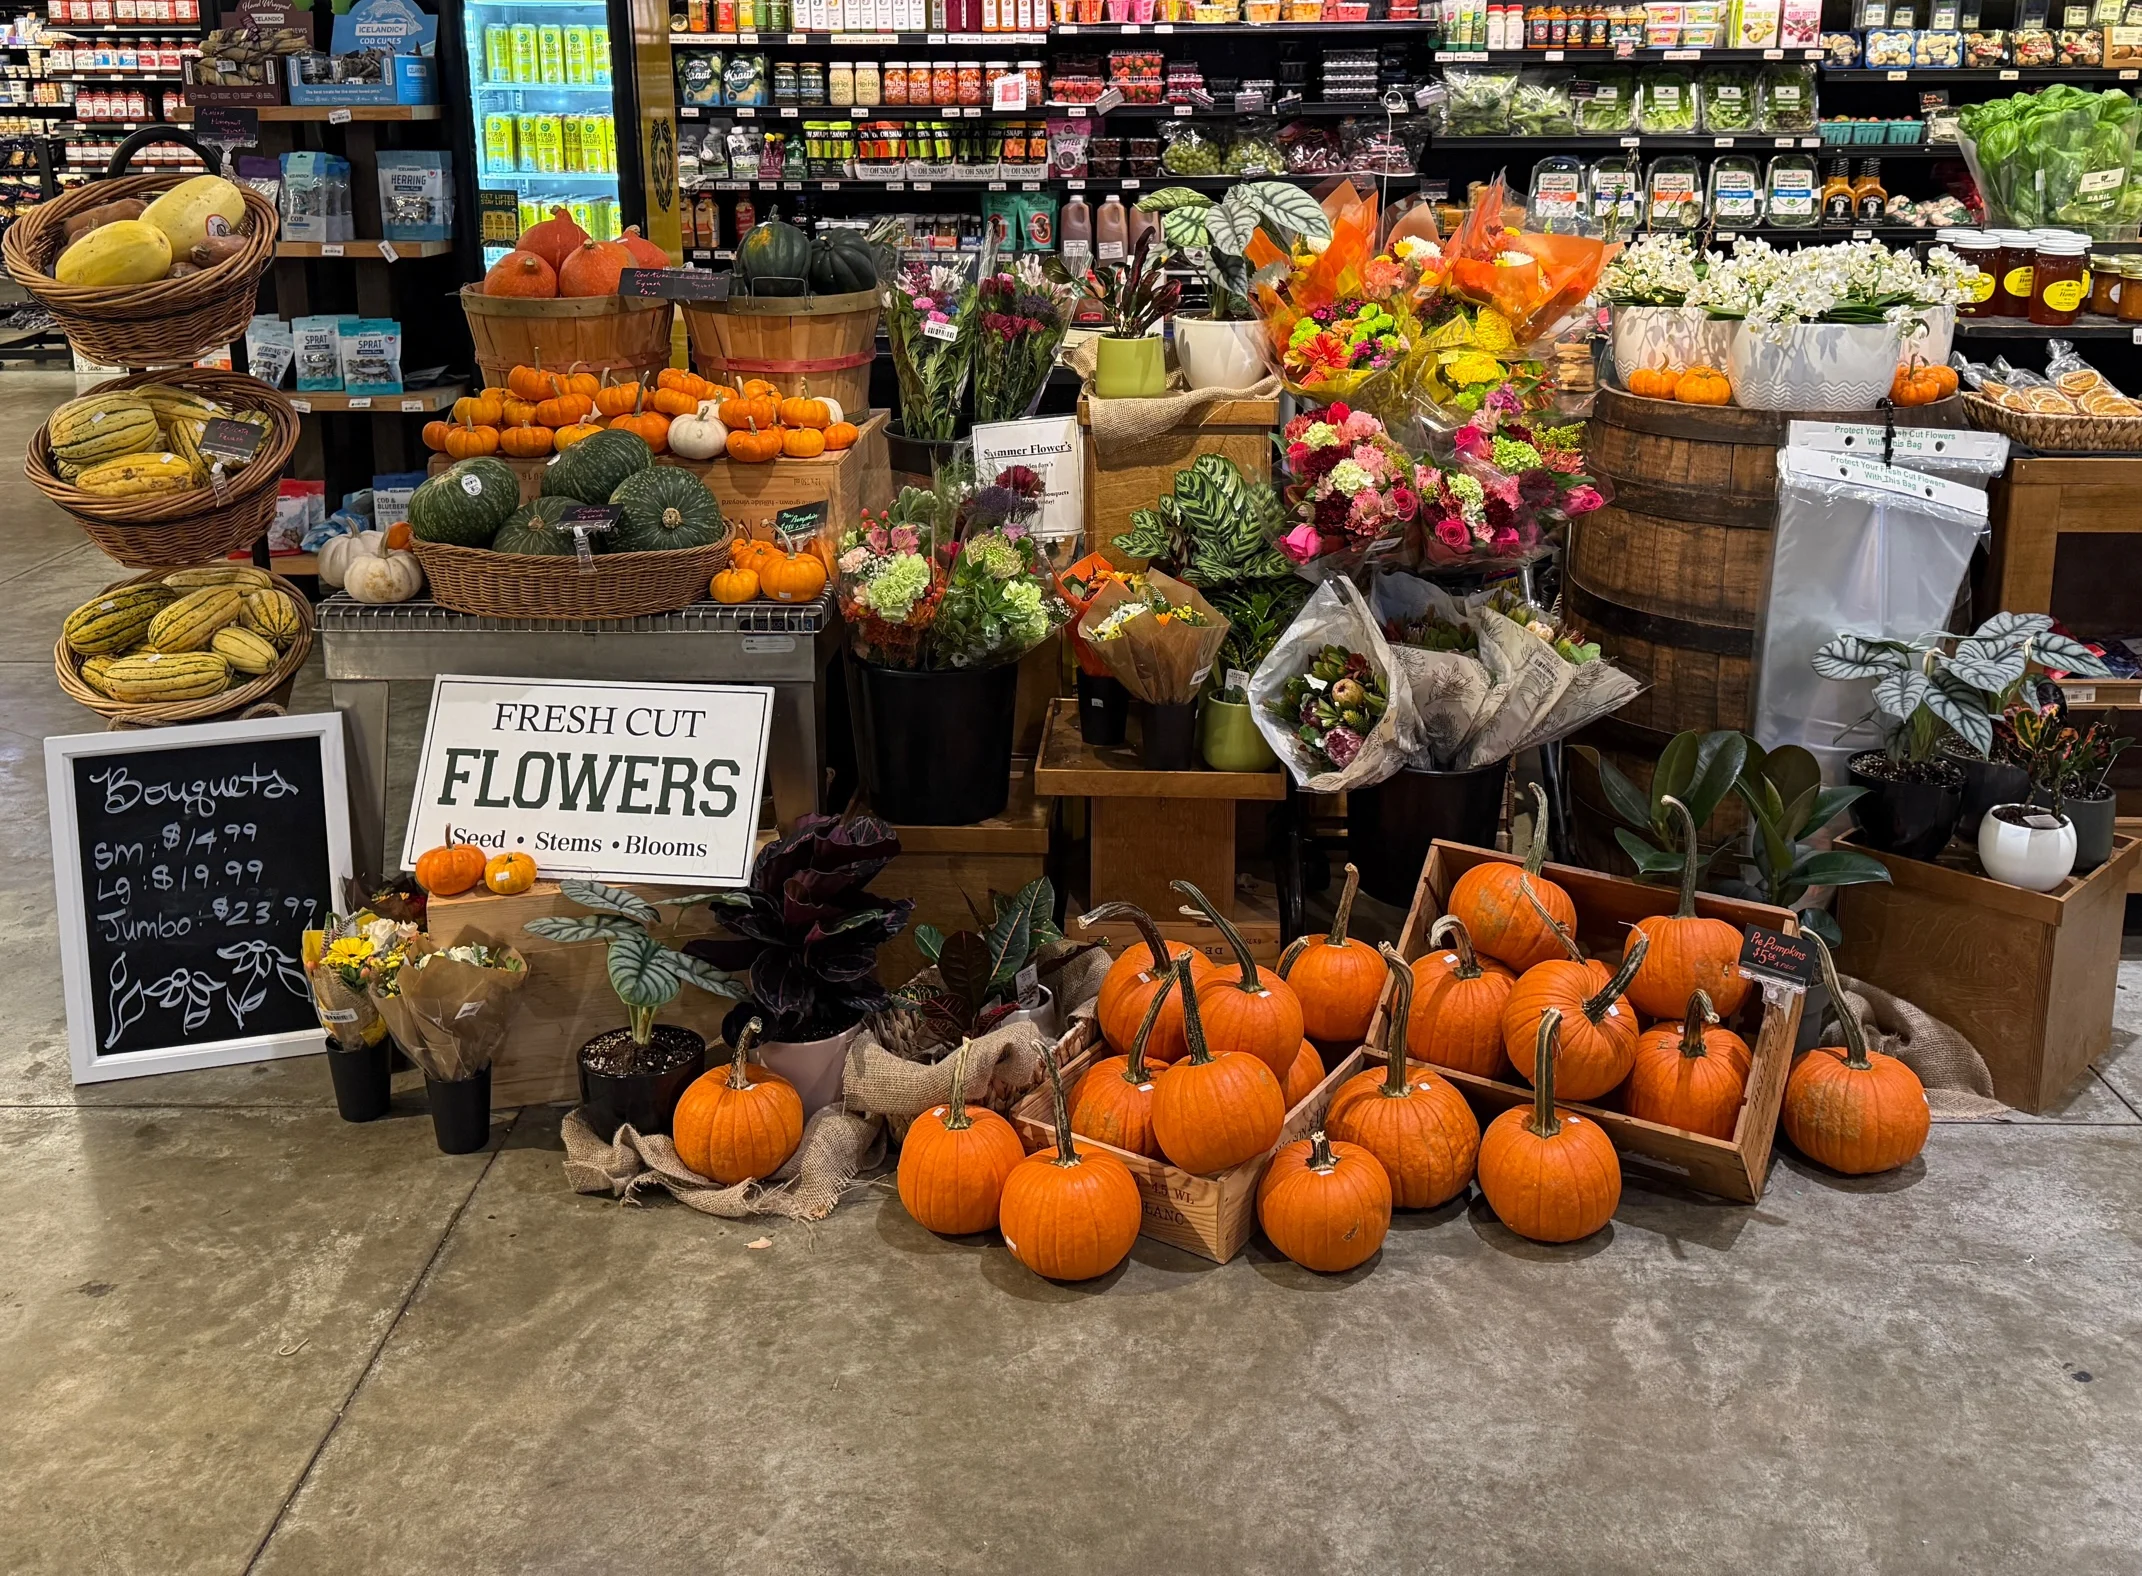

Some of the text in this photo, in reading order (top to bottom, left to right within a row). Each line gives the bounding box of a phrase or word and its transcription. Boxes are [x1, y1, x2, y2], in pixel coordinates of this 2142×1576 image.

[359, 24, 400, 33] ICELANDIC
[724, 68, 756, 81] Kraut
[391, 174, 426, 186] HERRING
[2087, 193, 2110, 202] BASIL
[305, 335, 328, 344] SPRAT
[358, 340, 382, 349] SPRAT
[1834, 426, 1864, 435] Protect
[1865, 427, 1883, 436] Your
[1909, 430, 1924, 438] Cut
[1925, 430, 1956, 440] Flowers
[984, 441, 1072, 458] Summer Flower's
[1906, 440, 1922, 450] Bag
[1830, 455, 1946, 488] Protect Your Fresh Cut Flowers
[1864, 471, 1917, 490] With This Bag
[790, 512, 820, 524] Pumpkin
[492, 702, 706, 738] FRESH CUT
[89, 762, 299, 818] Bouquets
[437, 748, 741, 818] FLOWERS
[162, 822, 257, 855] $14.99
[452, 828, 707, 857] Seed Stems Blooms
[152, 860, 263, 891] $19.99
[212, 896, 317, 927] $23.99
[1751, 932, 1806, 960] Pie Pumpkins
[1175, 1189, 1194, 1204] WL
